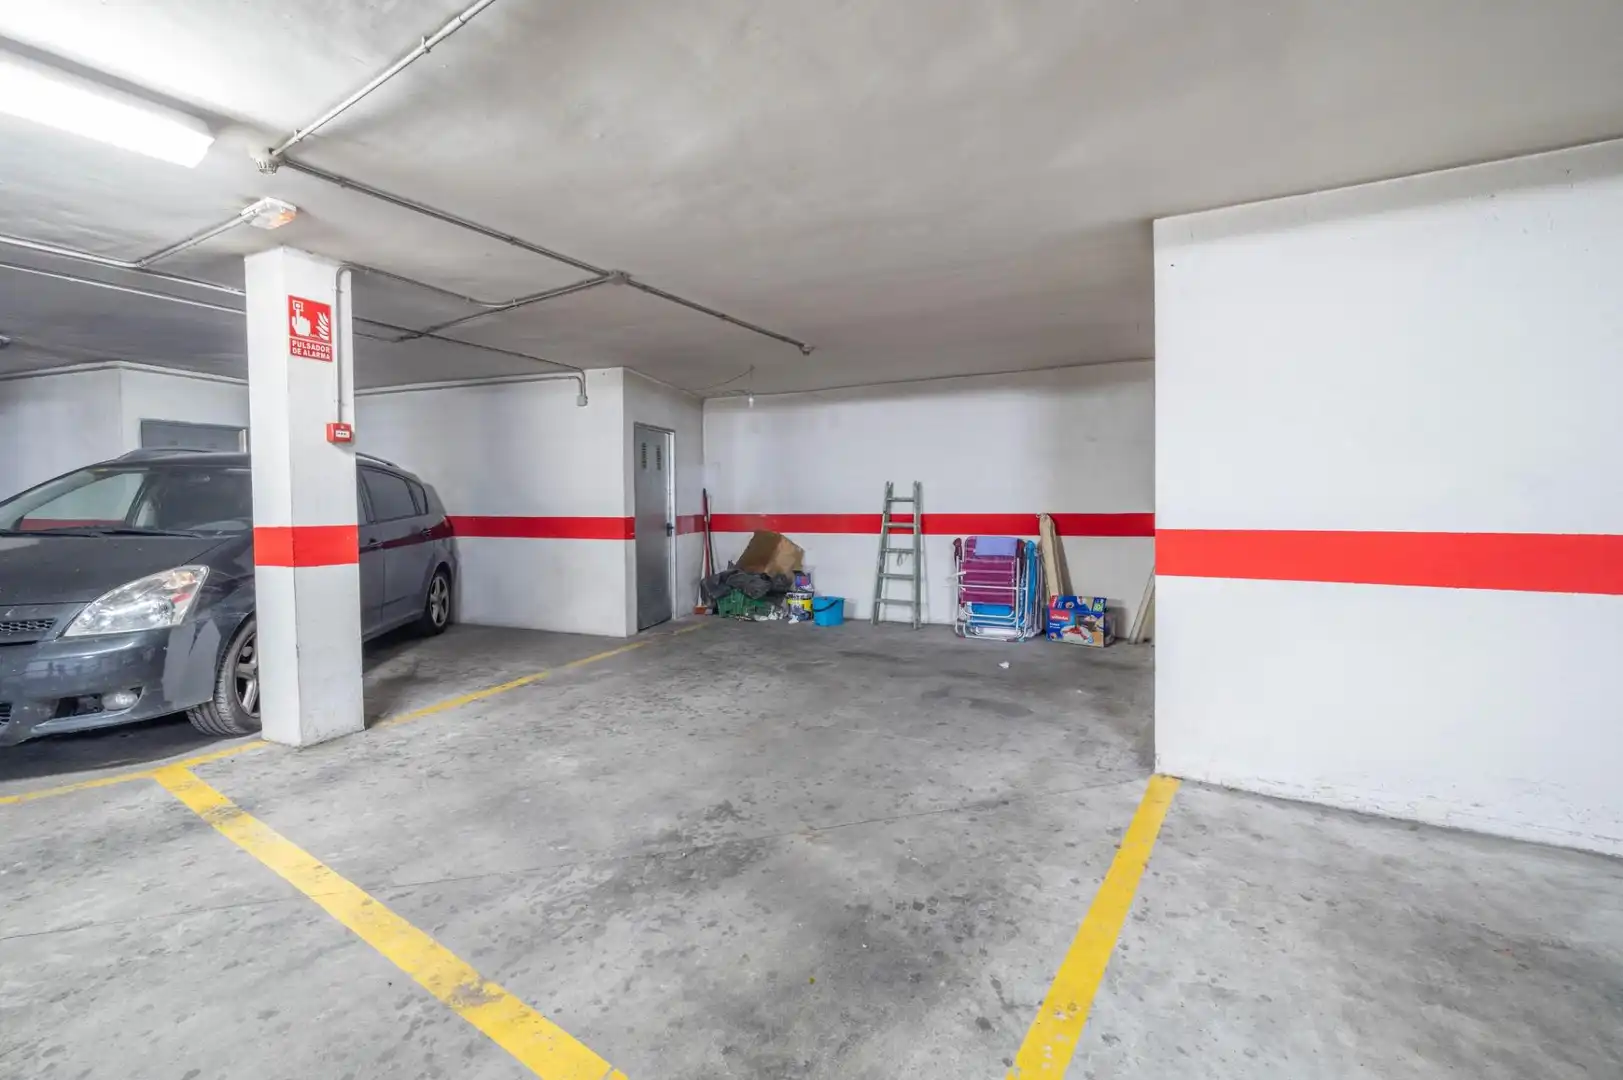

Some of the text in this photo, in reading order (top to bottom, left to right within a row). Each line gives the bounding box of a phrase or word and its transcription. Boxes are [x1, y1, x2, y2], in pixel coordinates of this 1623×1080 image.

[292, 340, 330, 353] PULSADOR
[292, 347, 331, 360] DE ALARMA
